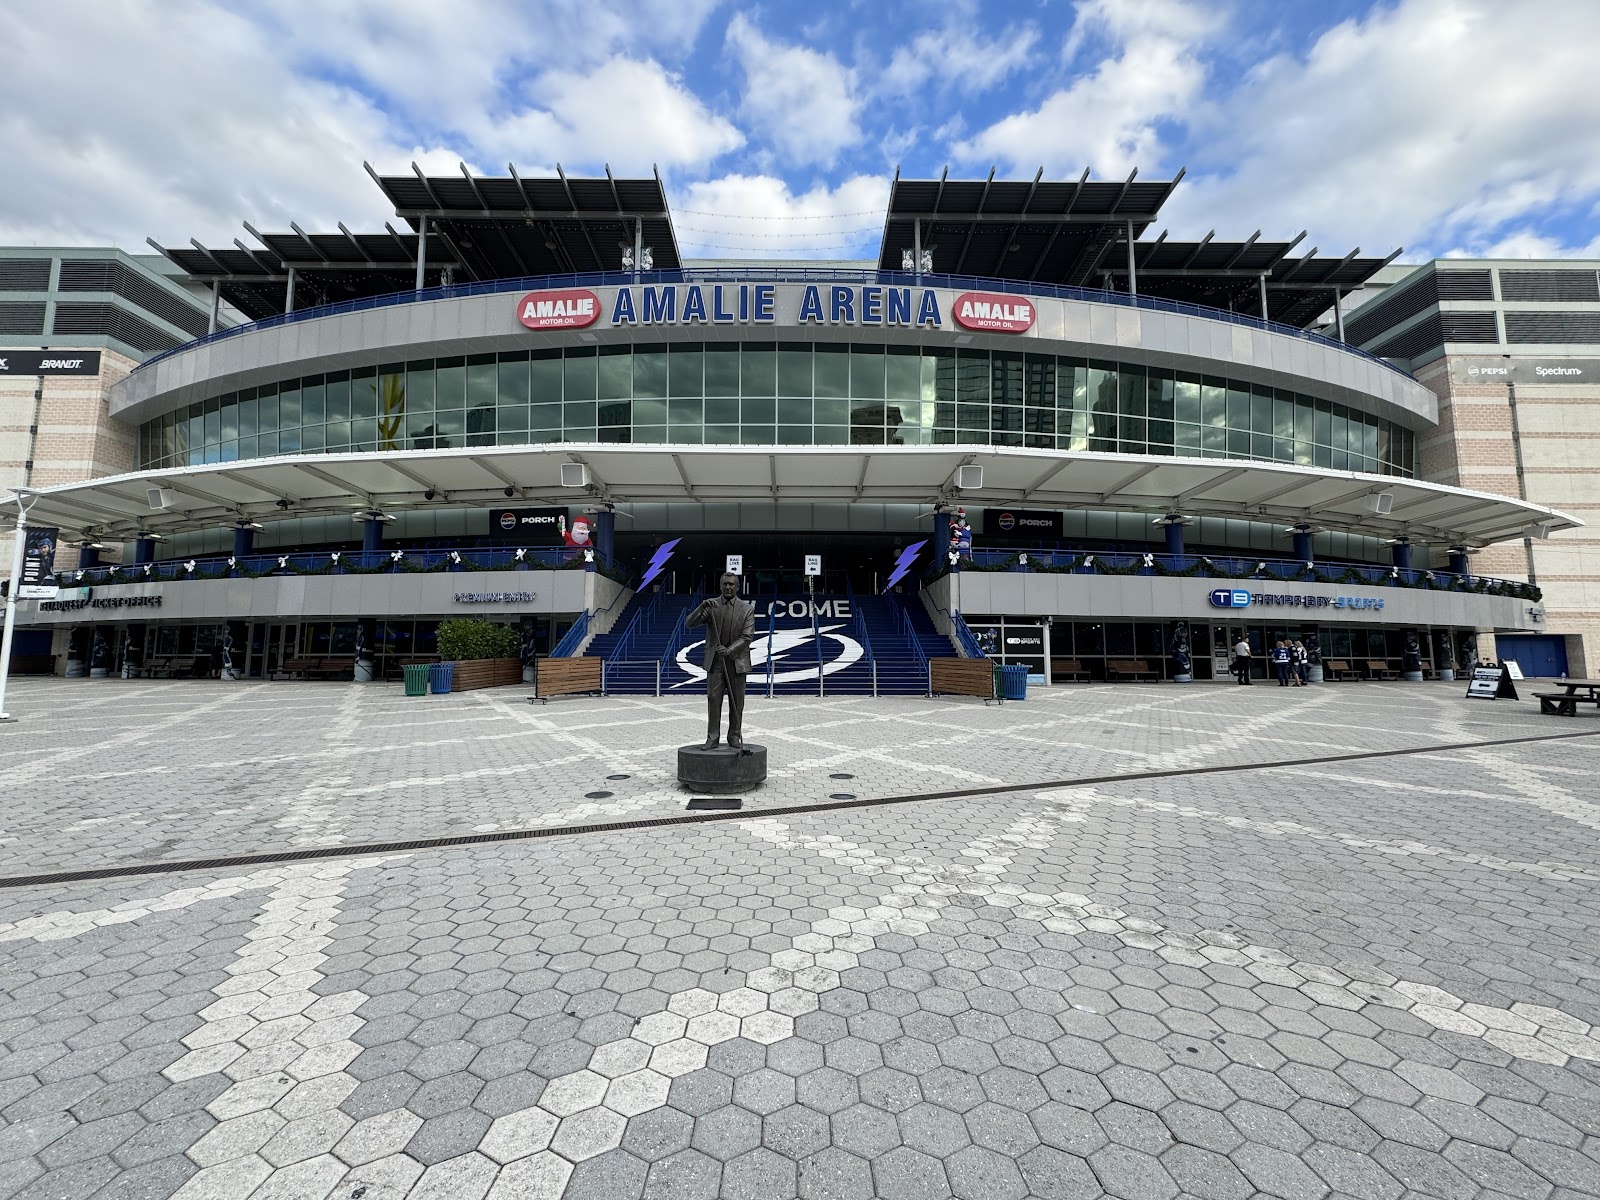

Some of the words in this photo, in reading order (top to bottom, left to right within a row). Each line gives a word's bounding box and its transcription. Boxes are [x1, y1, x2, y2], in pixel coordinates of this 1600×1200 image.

[522, 298, 594, 319] AMALIE
[610, 284, 776, 326] AMALIE
[798, 284, 943, 328] ARENA
[960, 301, 1031, 322] AMALIE
[39, 359, 83, 368] BRANDT
[1481, 367, 1508, 375] PEPSI
[1535, 366, 1579, 377] Spectrum
[521, 516, 555, 524] PORCH
[1019, 518, 1053, 527] PORCH
[23, 556, 41, 582] POINT
[92, 597, 122, 609] TICKET
[124, 595, 162, 608] OFFICE
[1336, 596, 1385, 609] SPORTS
